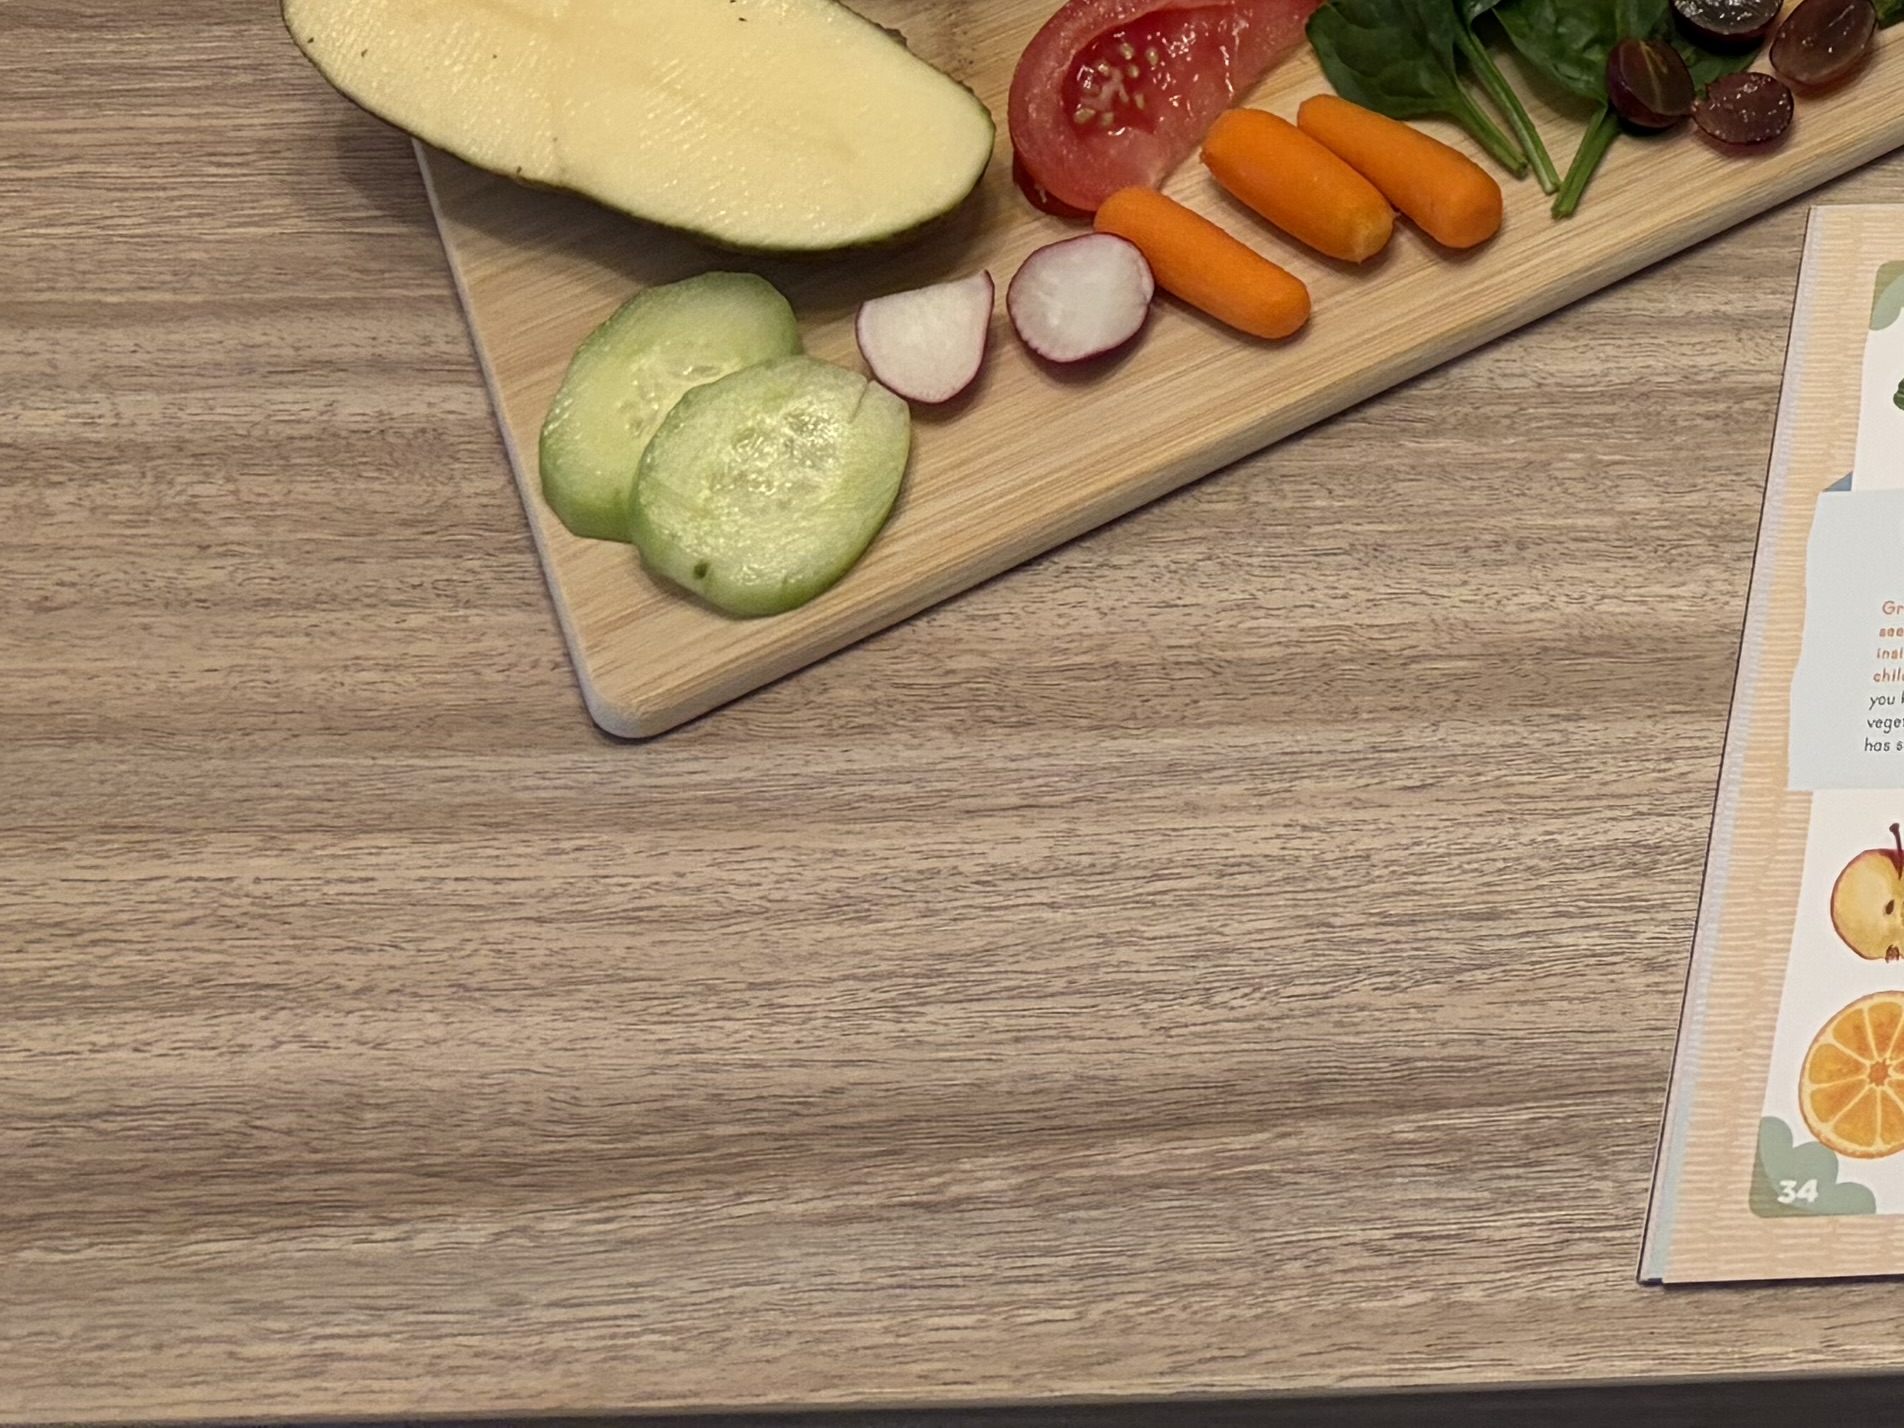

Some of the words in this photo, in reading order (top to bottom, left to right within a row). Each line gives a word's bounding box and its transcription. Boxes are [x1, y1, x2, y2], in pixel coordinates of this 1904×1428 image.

[1869, 696, 1895, 710] you
[1864, 737, 1890, 752] has
[1777, 1178, 1819, 1204] 34
